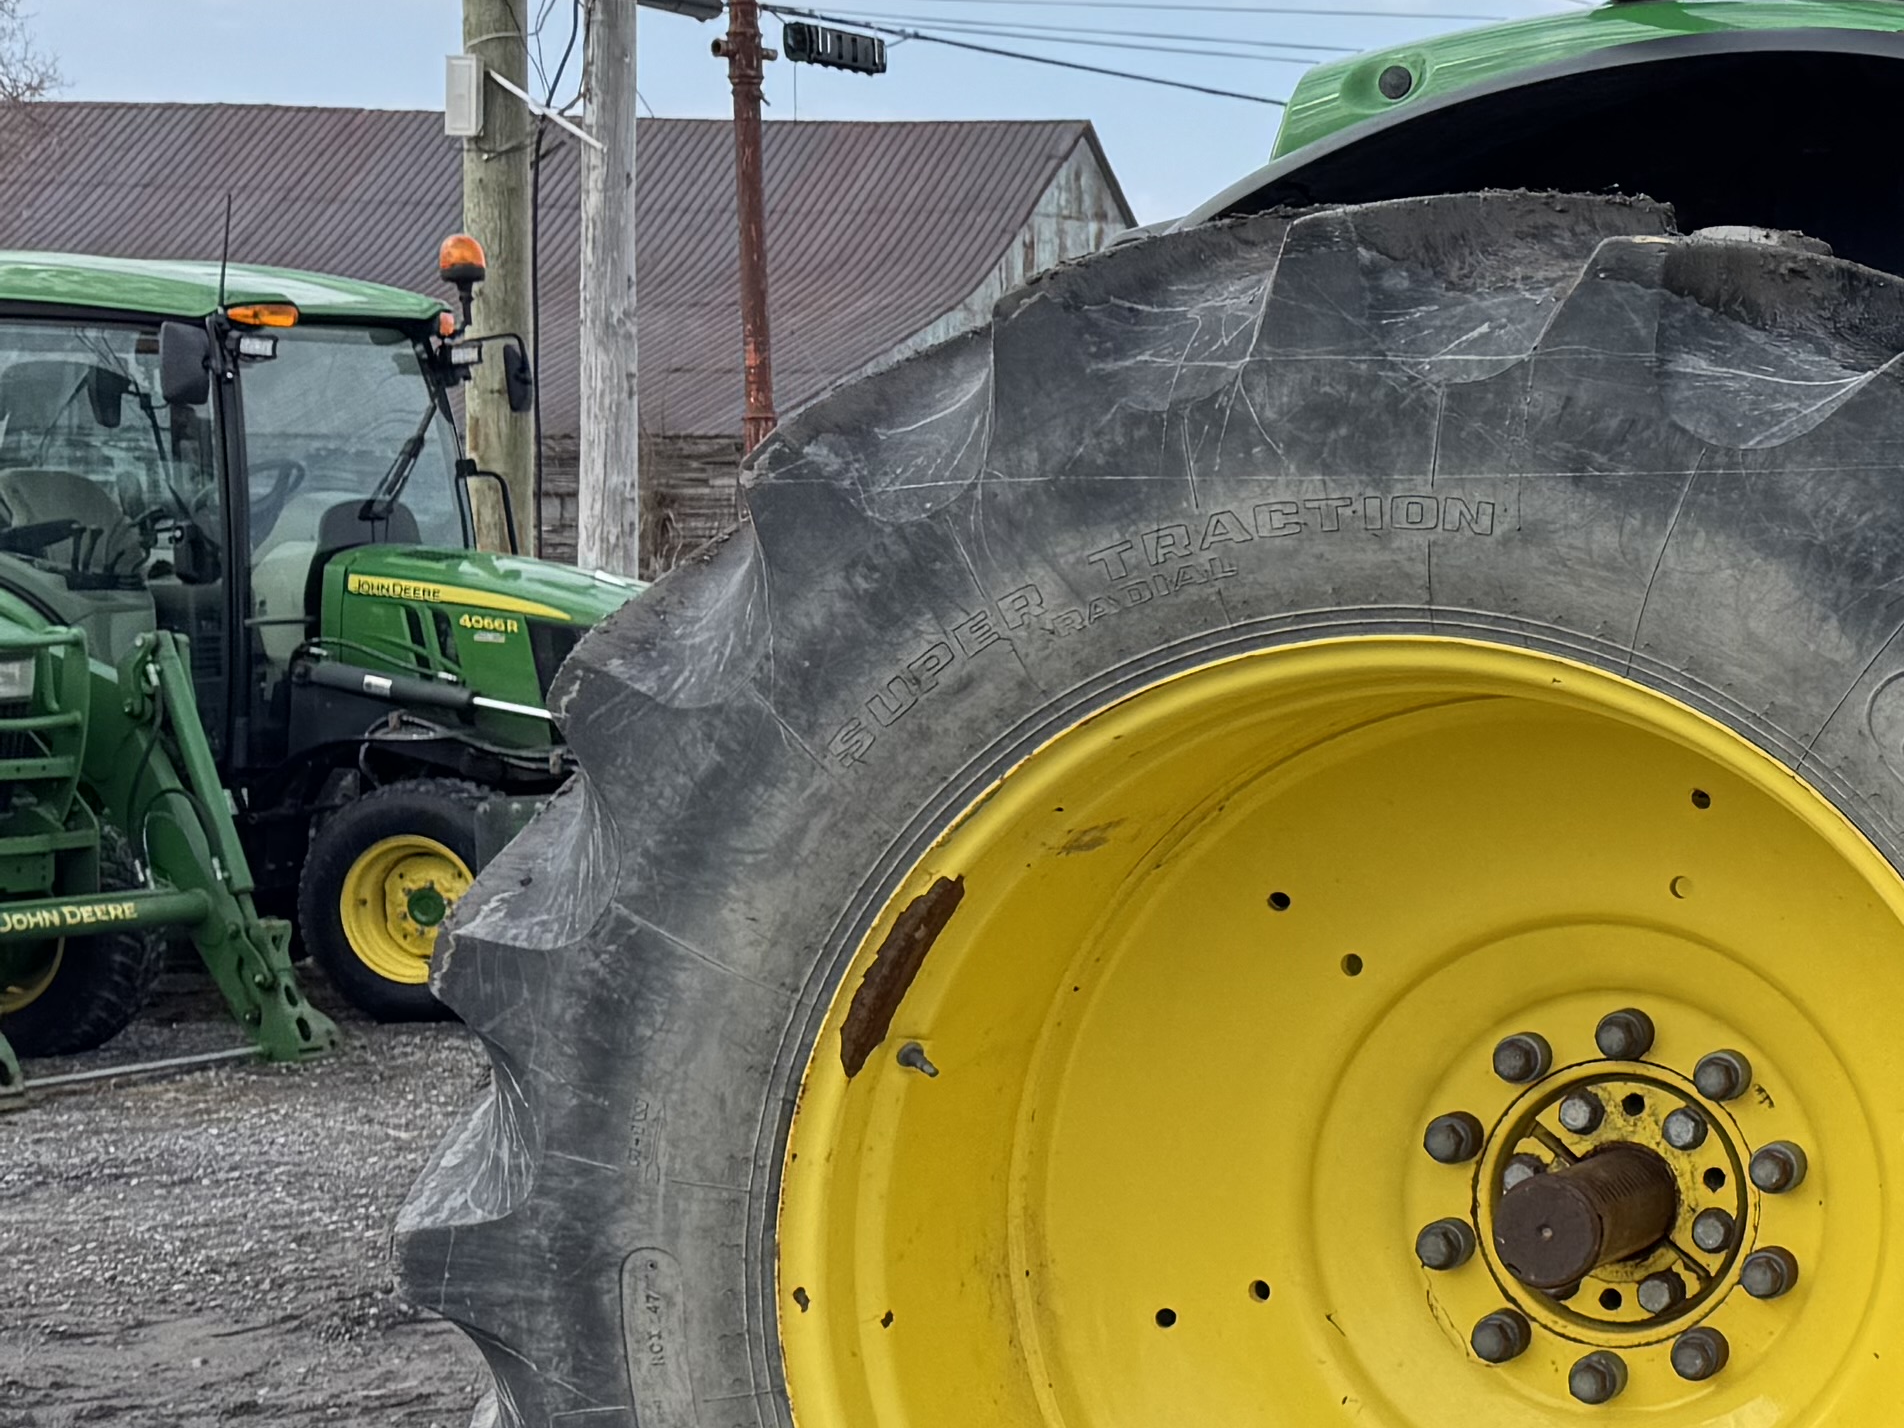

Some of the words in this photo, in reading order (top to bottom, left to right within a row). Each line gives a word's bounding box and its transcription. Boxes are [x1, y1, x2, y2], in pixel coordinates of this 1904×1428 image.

[356, 578, 391, 595] JOHN
[392, 580, 441, 600] DEERE
[1047, 555, 1239, 638] RADIAL
[826, 583, 1049, 769] SUPER
[1087, 491, 1497, 583] TRACTION
[0, 908, 60, 933] JOHN
[61, 902, 139, 926] DEERE
